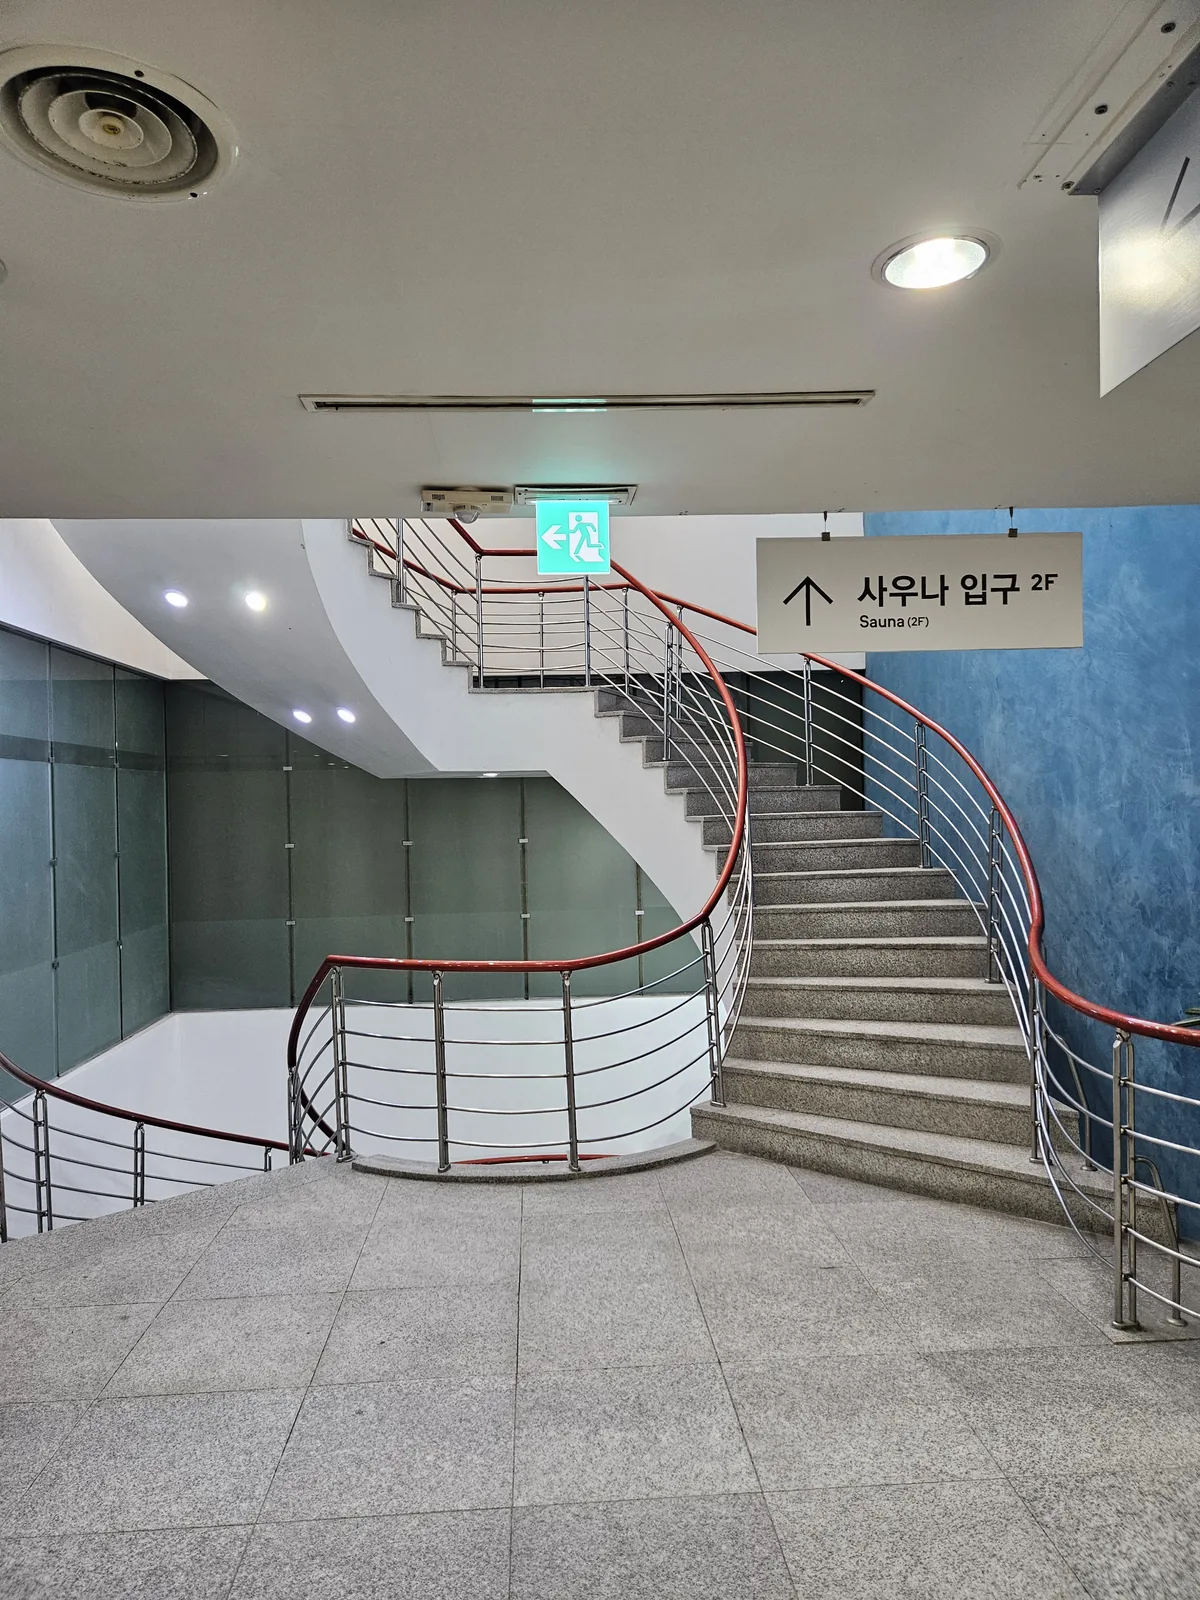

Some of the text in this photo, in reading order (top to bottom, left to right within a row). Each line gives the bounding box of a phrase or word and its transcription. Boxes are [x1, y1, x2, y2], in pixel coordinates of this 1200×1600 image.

[857, 573, 1058, 607] 사우나 입구 2F
[859, 614, 929, 628] Sauna (2F)
